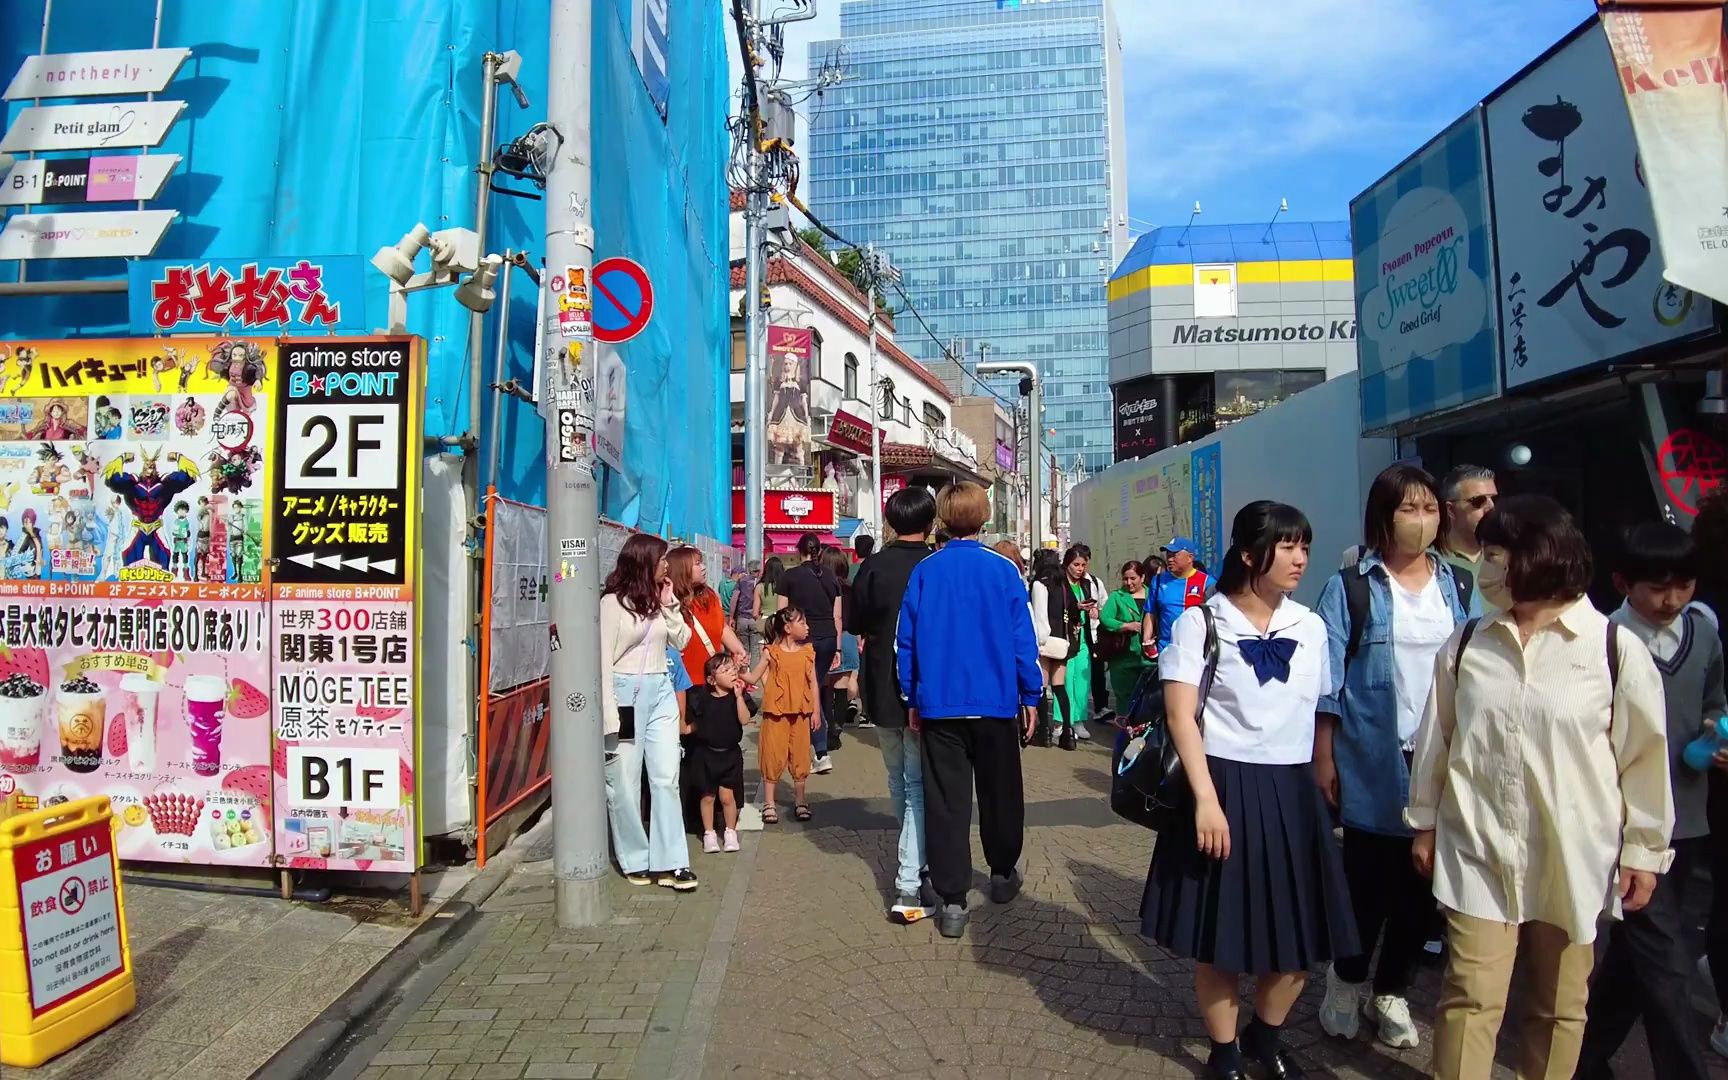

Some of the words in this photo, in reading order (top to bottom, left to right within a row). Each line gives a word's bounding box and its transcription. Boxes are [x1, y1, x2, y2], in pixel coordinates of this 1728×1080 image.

[46, 64, 140, 83] northerly
[53, 123, 83, 135] Petit
[87, 121, 120, 138] glam
[1382, 251, 1413, 276] Frozen
[1414, 225, 1454, 259] Popcorn
[152, 262, 340, 328] おそ松さん
[1399, 318, 1419, 335] Good
[1421, 304, 1443, 326] Grief
[1172, 323, 1324, 344] Matsumoto
[289, 347, 346, 367] anime
[351, 348, 401, 367] store
[300, 414, 385, 478] 2F
[561, 540, 586, 549] VISAH
[22, 583, 46, 595] store
[109, 583, 122, 596] 2F
[126, 585, 189, 597] アニメストア
[279, 586, 292, 599] 2F
[295, 587, 324, 600] anime
[326, 587, 351, 600] store
[279, 608, 407, 631] 世界300店舗
[280, 633, 408, 665] 関東1号店
[80, 655, 149, 672] おすすめ単品
[334, 717, 402, 737] モグティー
[301, 755, 385, 802] B1F
[35, 834, 98, 873] お願い
[87, 875, 110, 897] 禁止
[30, 895, 58, 918] 飲食
[32, 958, 44, 968] Do
[45, 950, 58, 962] not
[60, 944, 72, 956] eat
[73, 941, 81, 950] or
[82, 932, 99, 946] drink
